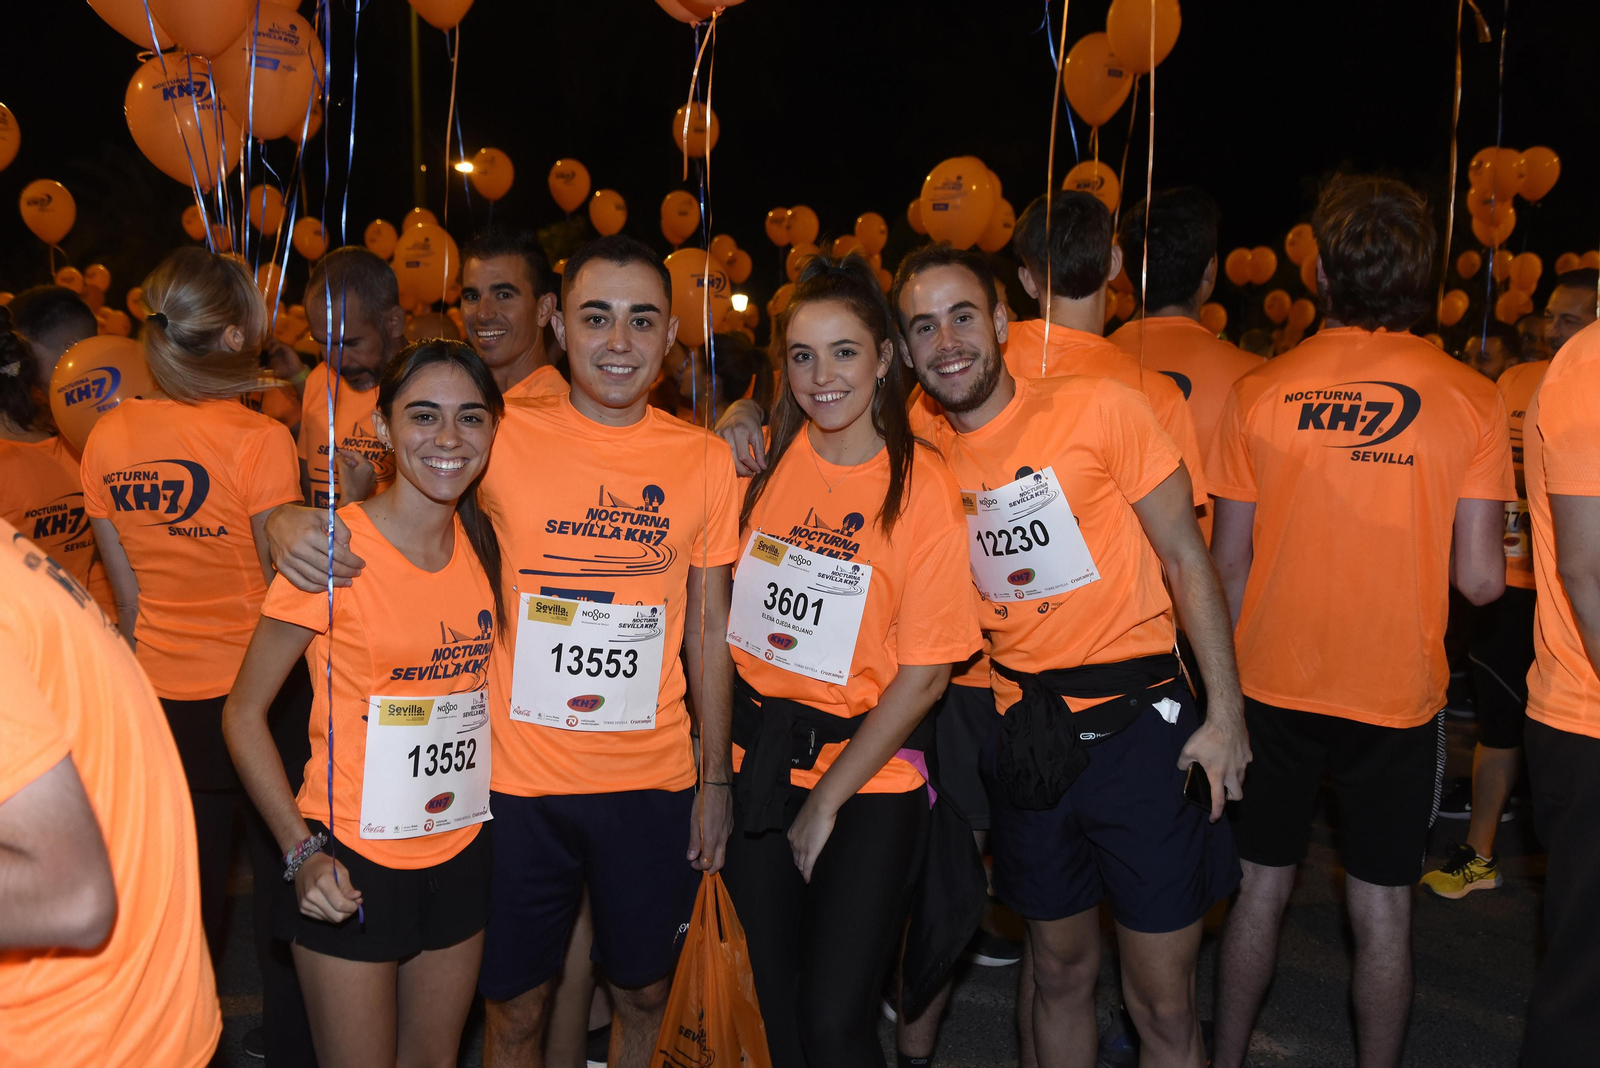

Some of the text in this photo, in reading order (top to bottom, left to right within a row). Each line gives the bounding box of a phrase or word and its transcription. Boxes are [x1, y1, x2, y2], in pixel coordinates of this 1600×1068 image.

[1284, 390, 1362, 403] NOCTURNA
[1350, 450, 1414, 466] SEVILLA
[103, 471, 158, 485] NOCTURNA
[1020, 482, 1048, 497] NOCTURNA
[1008, 494, 1035, 508] SEVILLA
[25, 503, 68, 519] NOCTURNA
[586, 508, 670, 530] NOCTURNA
[168, 526, 228, 538] SEVILLA
[545, 519, 621, 540] SEVILLA
[789, 526, 860, 554] NOCTURNA
[976, 520, 1050, 556] 12230
[817, 572, 843, 583] SEVILLA
[831, 570, 861, 581] NOCTURNA
[764, 582, 824, 626] 3601
[762, 612, 814, 636] ELENA OJEDA ROJANO
[551, 642, 638, 679] 13553
[390, 663, 462, 680] SEVILLA
[408, 738, 477, 777] 13552
